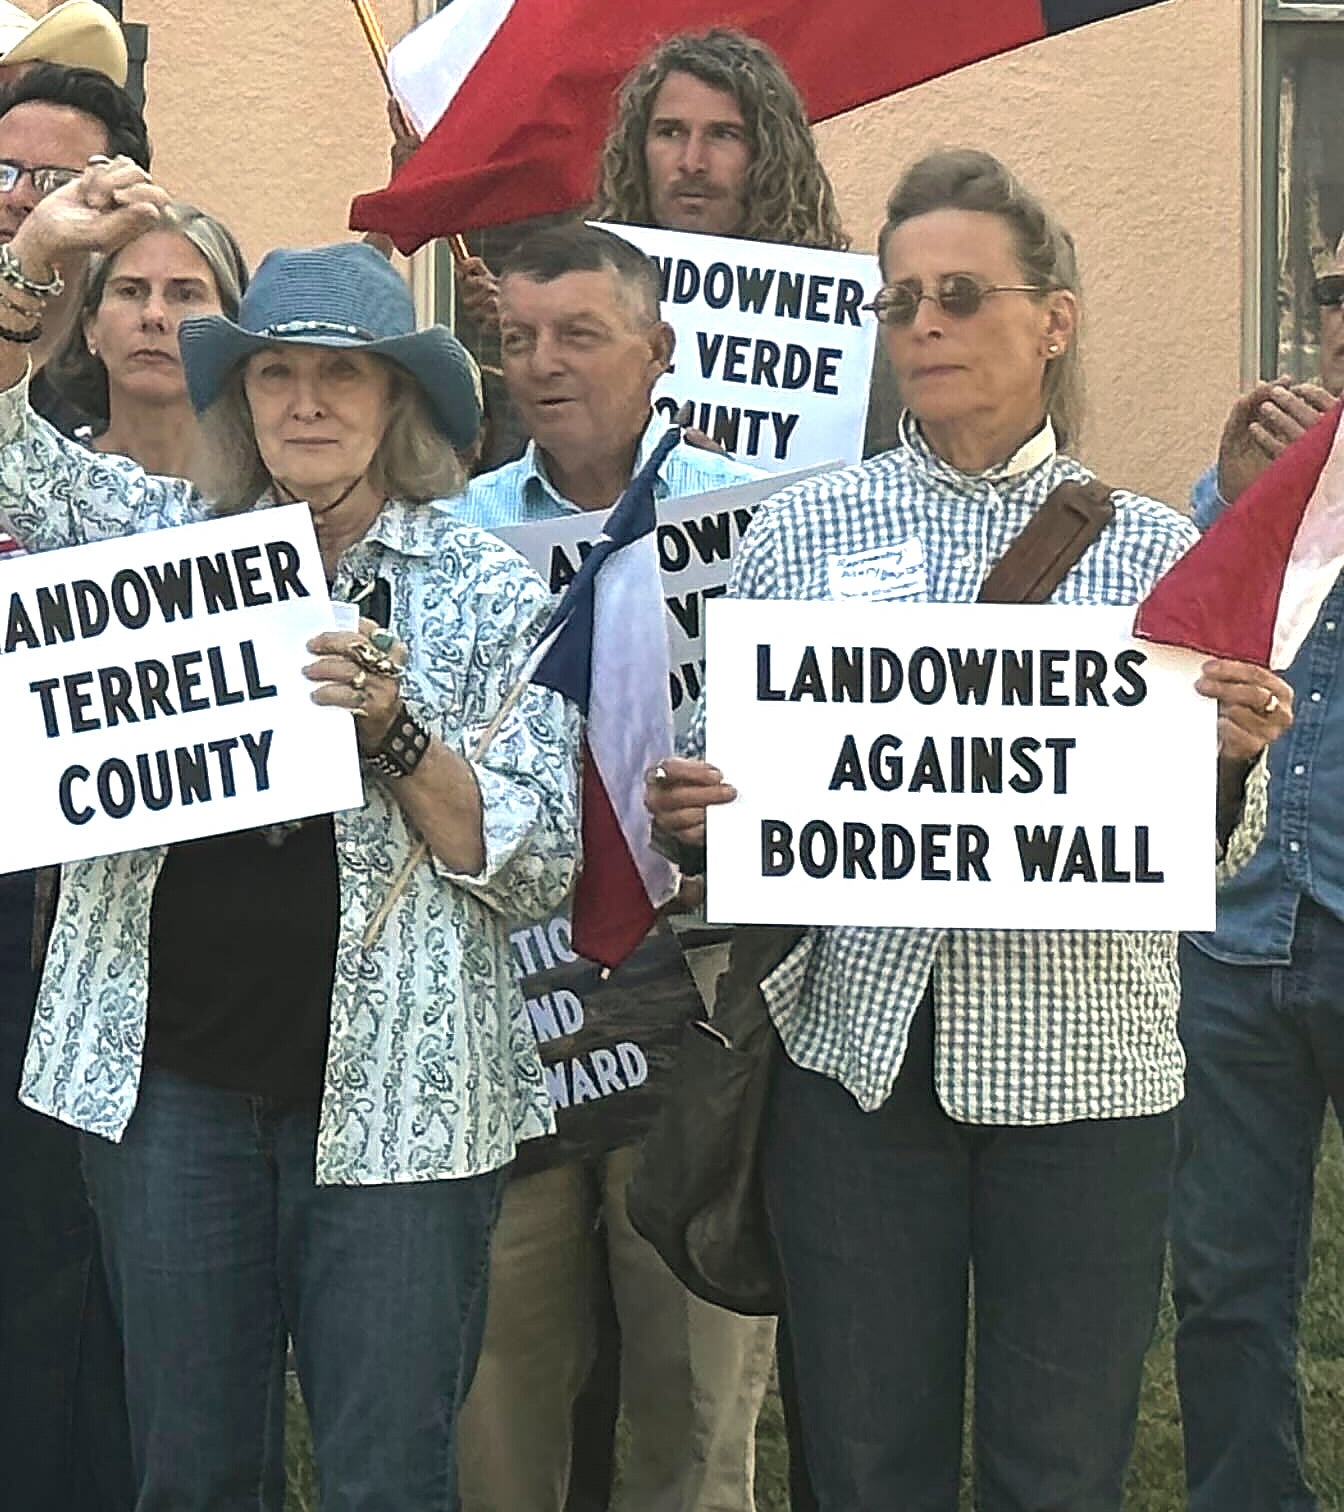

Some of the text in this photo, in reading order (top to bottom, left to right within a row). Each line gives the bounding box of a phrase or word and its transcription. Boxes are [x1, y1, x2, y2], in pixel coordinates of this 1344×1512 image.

[696, 331, 843, 395] VERDE
[29, 640, 278, 738] TERRELL
[756, 644, 1148, 707] LANDOWNERS
[59, 730, 274, 826] COUNTY
[828, 734, 1077, 794] AGAINST
[761, 819, 1165, 884] BORDER WALL
